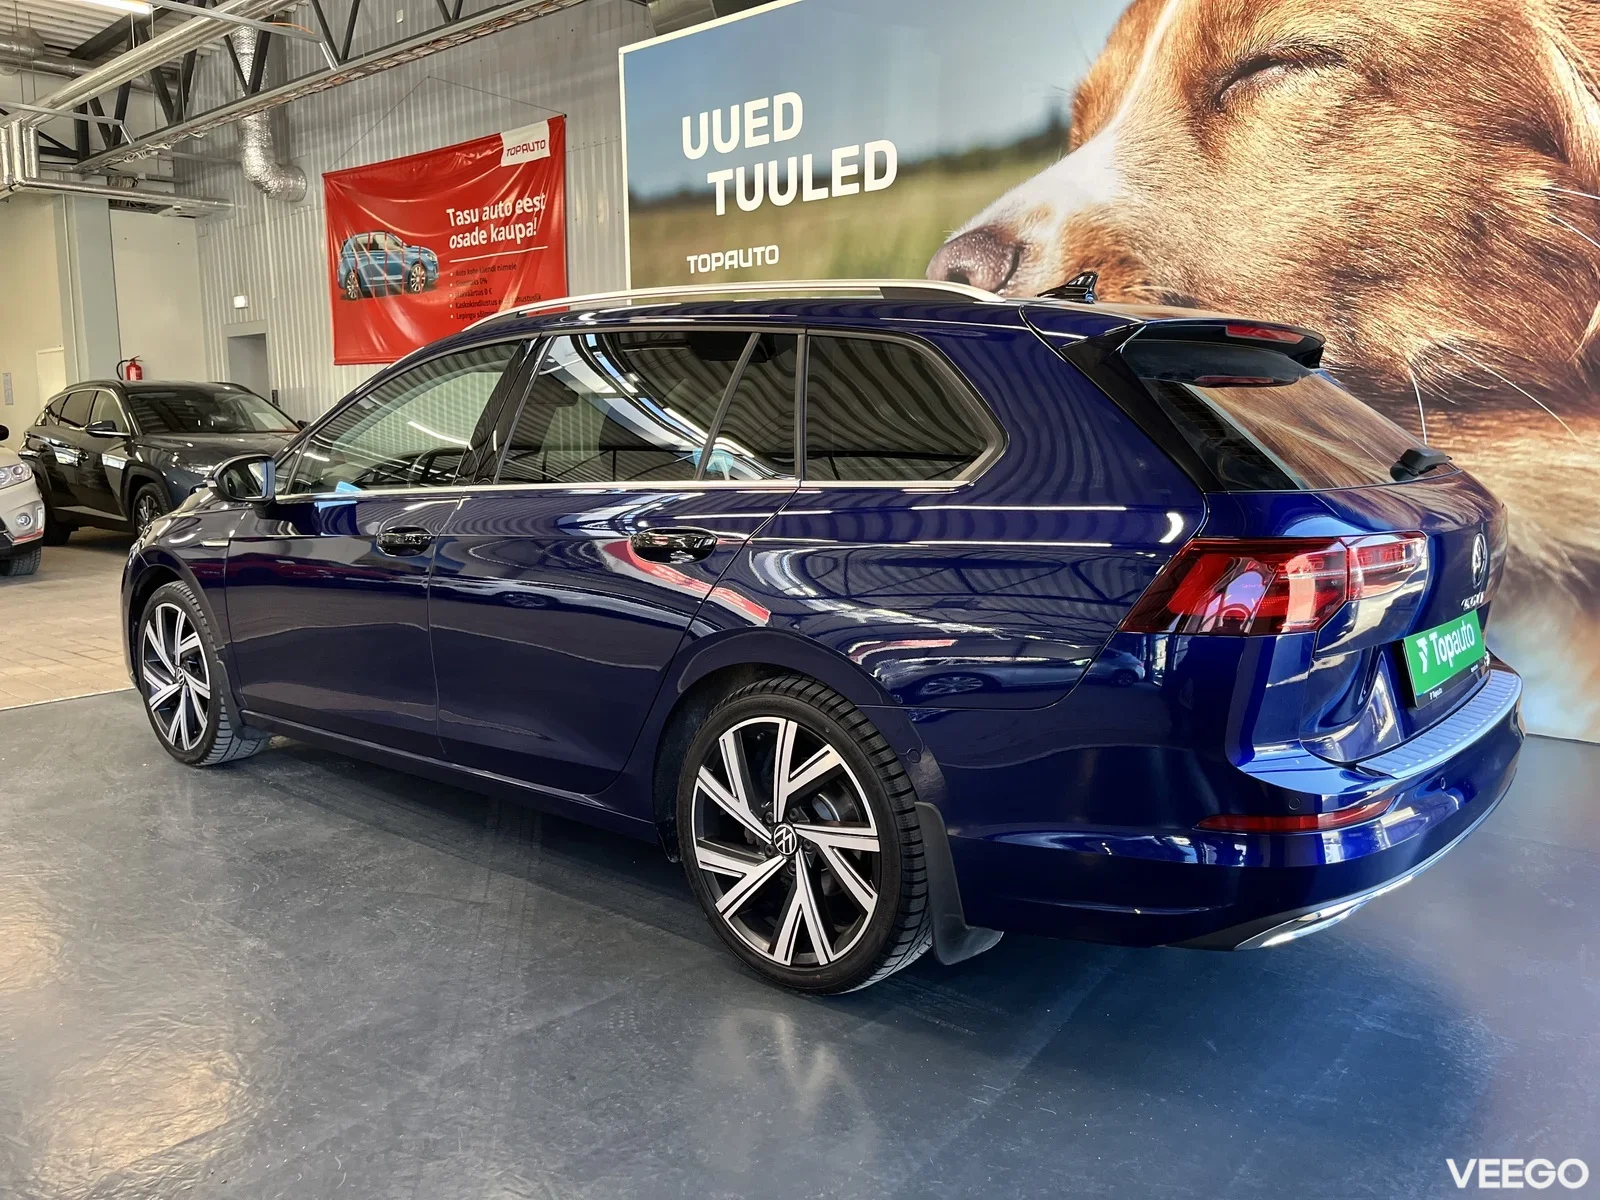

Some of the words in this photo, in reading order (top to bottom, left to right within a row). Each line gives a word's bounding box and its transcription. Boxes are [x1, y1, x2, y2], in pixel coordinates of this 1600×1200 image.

[682, 91, 804, 160] UUED
[506, 139, 546, 157] TOPAUTO
[706, 139, 898, 216] TUULED
[446, 208, 479, 227] Tasu
[482, 202, 513, 221] auto
[515, 193, 546, 214] eest
[449, 226, 488, 249] osade
[490, 217, 537, 244] kaupa!
[686, 244, 780, 274] TOPAUTO
[1428, 620, 1475, 668] Topauto
